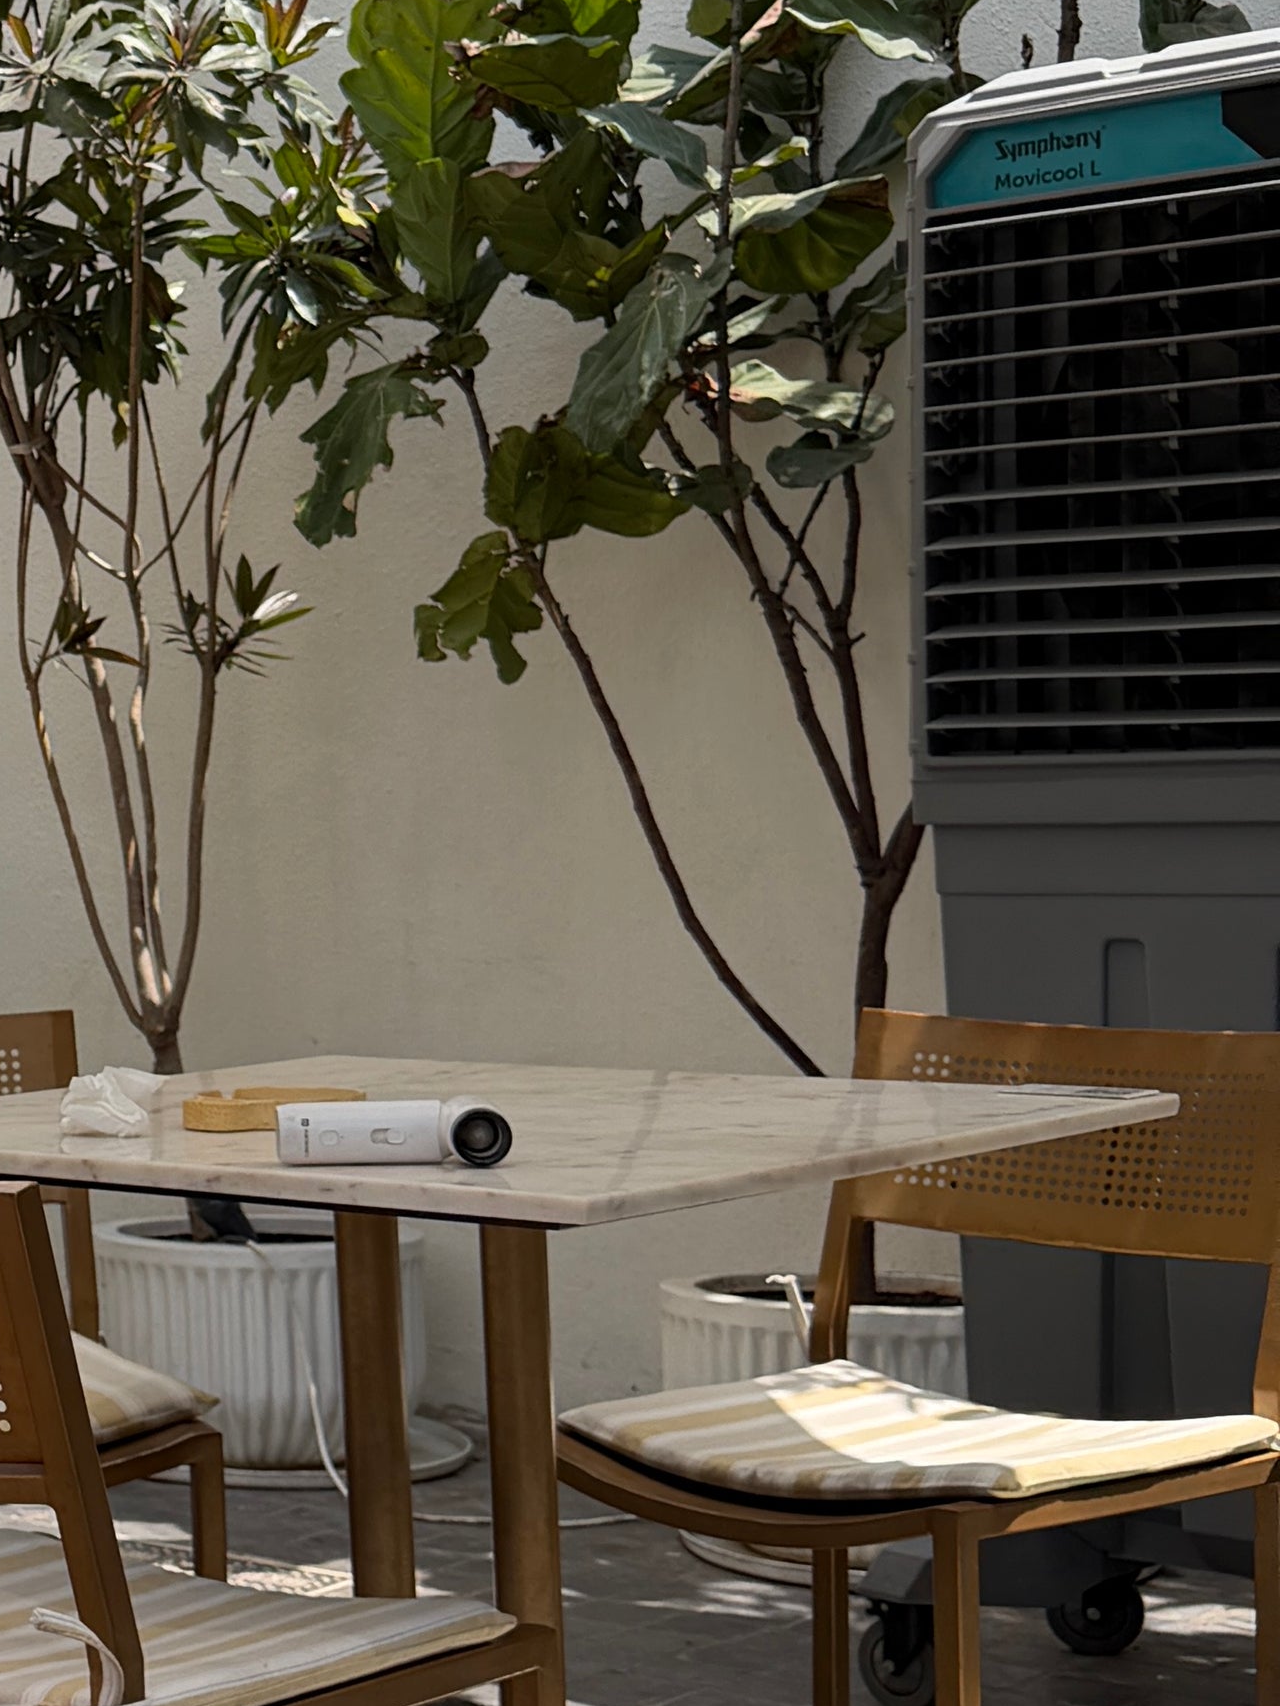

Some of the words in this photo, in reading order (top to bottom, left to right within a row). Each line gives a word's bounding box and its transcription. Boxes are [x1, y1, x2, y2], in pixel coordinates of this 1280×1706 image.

[994, 129, 1102, 163] Symphony
[994, 162, 1084, 192] Movicool
[1089, 159, 1102, 177] L
